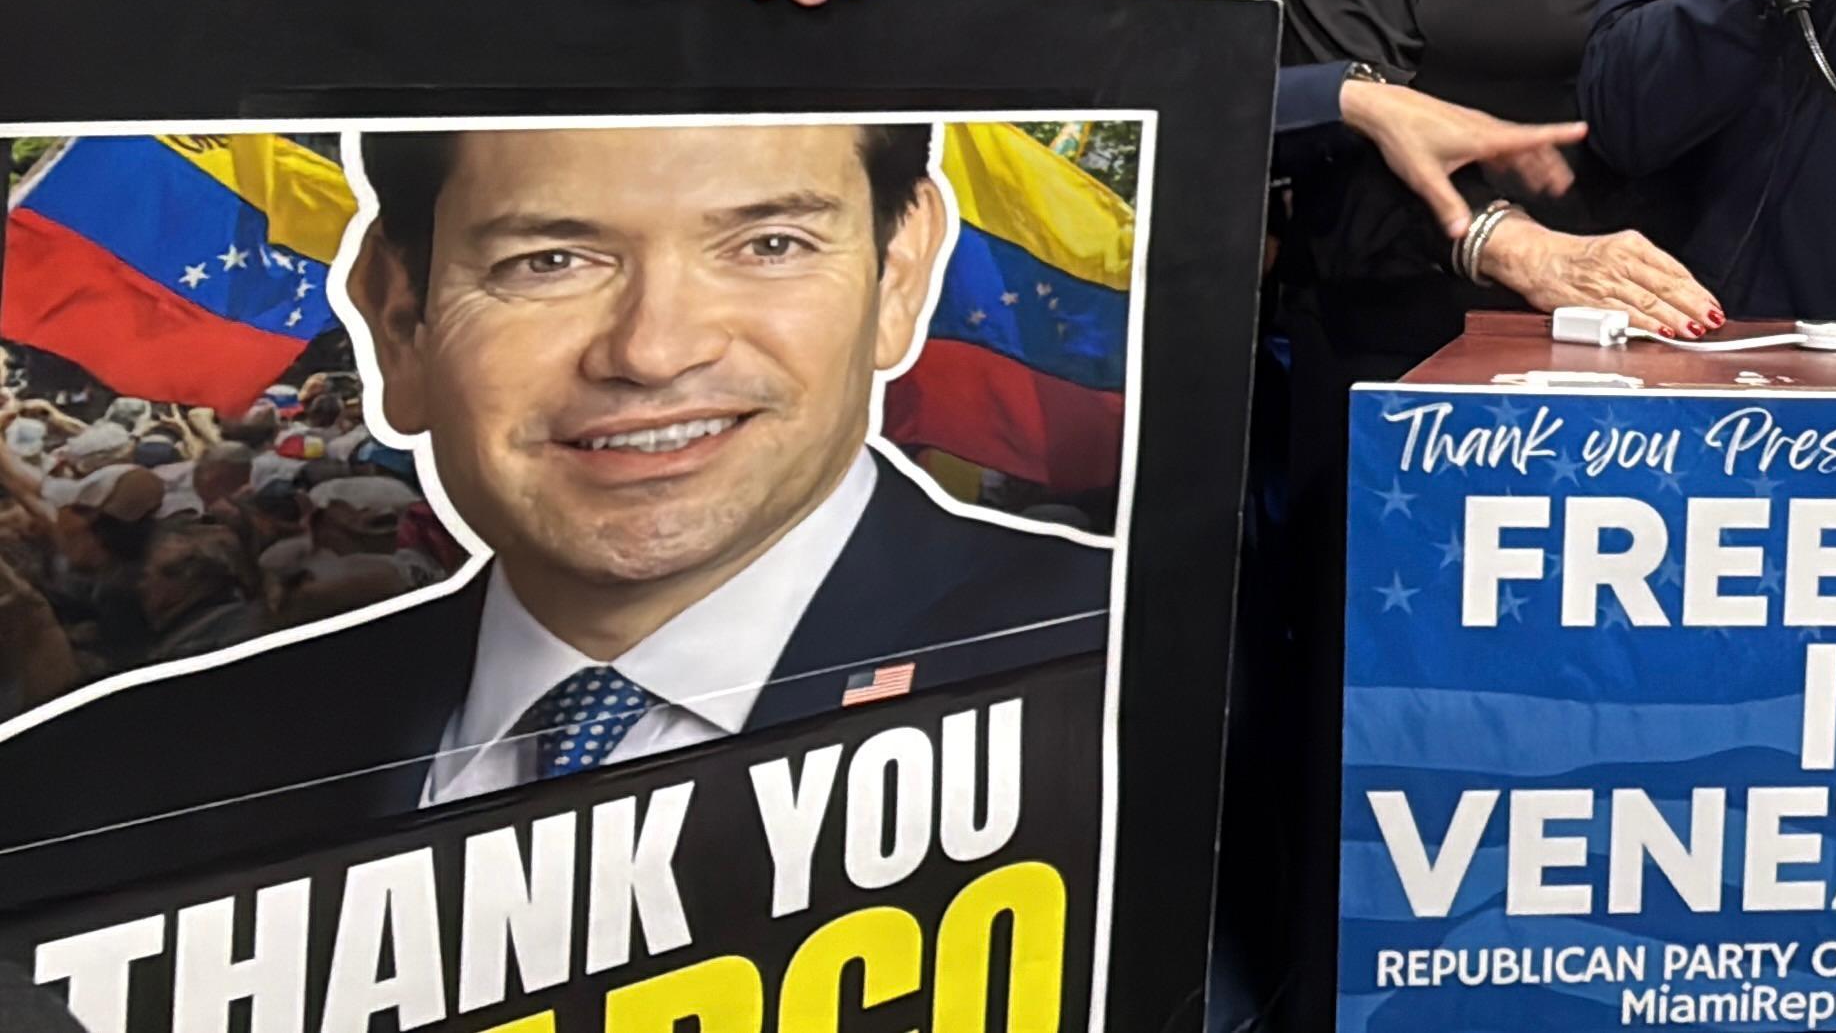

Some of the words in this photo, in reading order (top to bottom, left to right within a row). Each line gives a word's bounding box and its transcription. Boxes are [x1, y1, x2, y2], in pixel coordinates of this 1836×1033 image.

[1384, 402, 1563, 476] Thank
[1582, 428, 1681, 477] you
[34, 779, 695, 1033] THANK
[749, 697, 1023, 919] YOU
[1376, 945, 1646, 987] REPUBLICAN
[1663, 941, 1800, 982] PARTY
